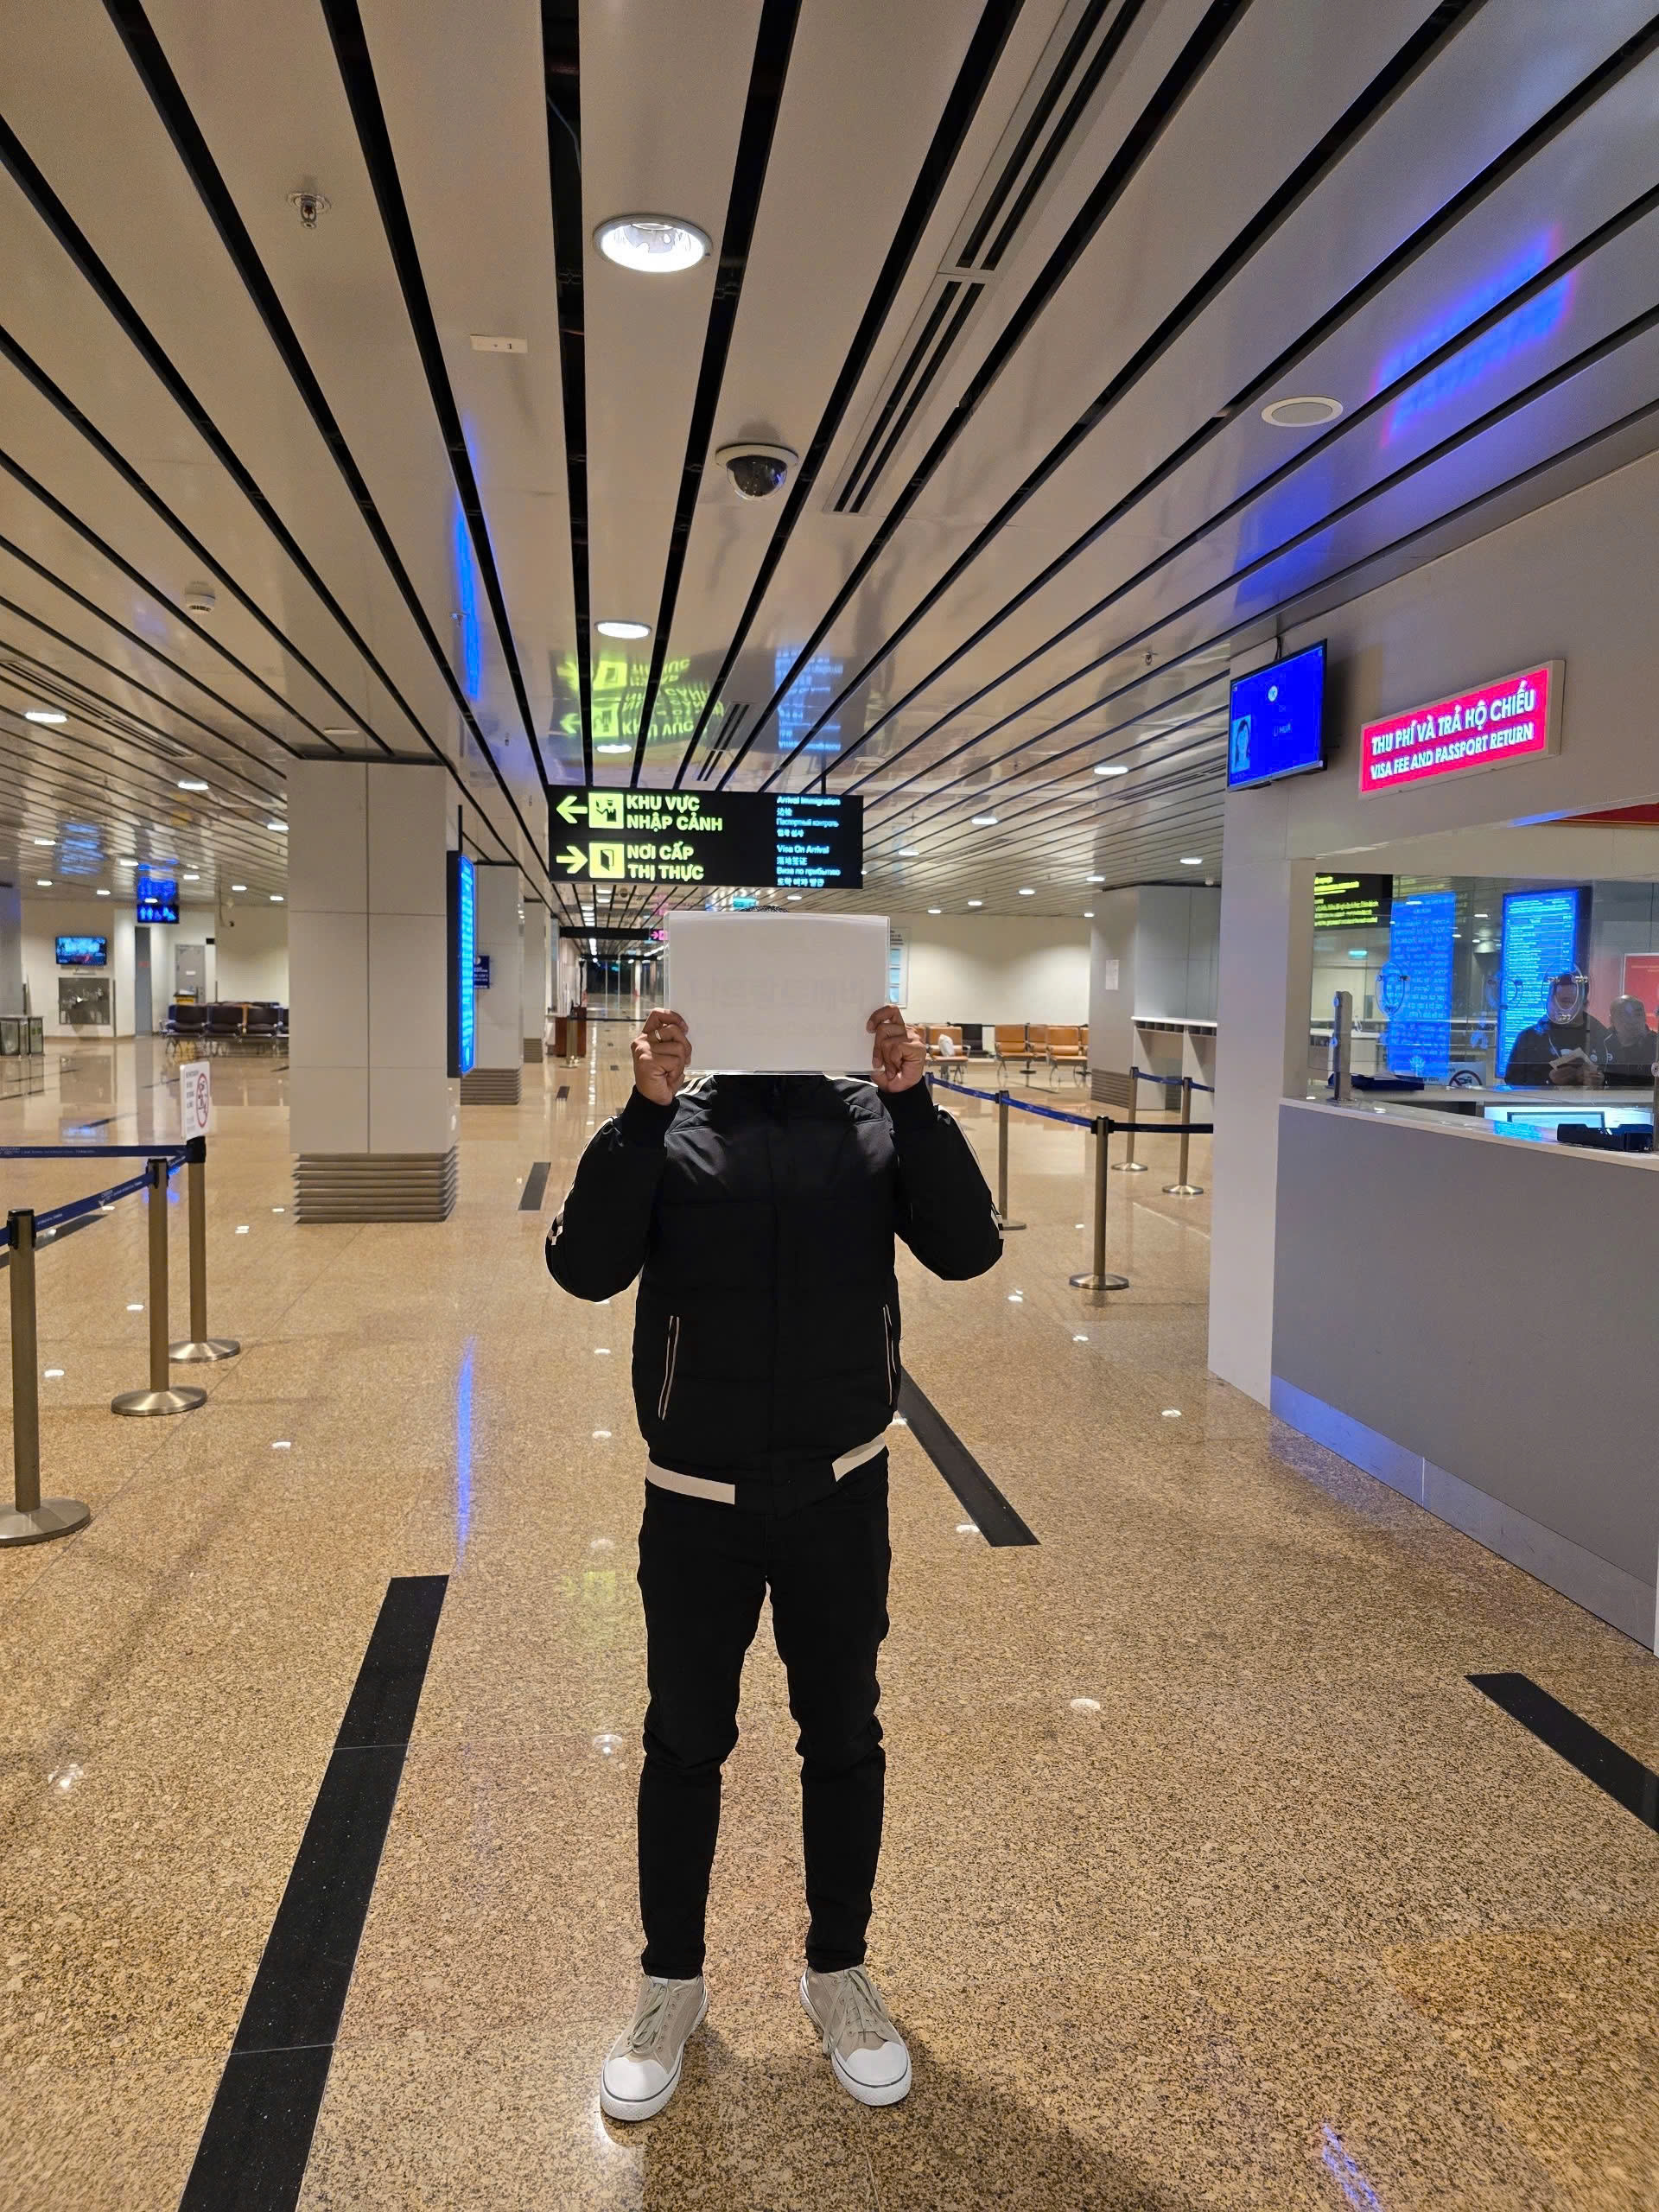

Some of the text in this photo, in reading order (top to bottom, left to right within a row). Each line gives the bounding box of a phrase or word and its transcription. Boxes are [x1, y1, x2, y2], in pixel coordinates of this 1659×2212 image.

[1371, 680, 1535, 756] THU PHÍ VÀ TRẢ HỘ CHIẾU
[1370, 721, 1535, 780] VISA FEE AND PASSPORT RETURN
[626, 795, 700, 813] KHU VỰC
[777, 796, 842, 807] Arrival Immigration
[626, 812, 723, 832] NHẬP CẢNH
[627, 841, 694, 861] NƠI CẤP
[777, 844, 830, 855] Visa On Arrival
[627, 864, 704, 881] THỊ THỰC
